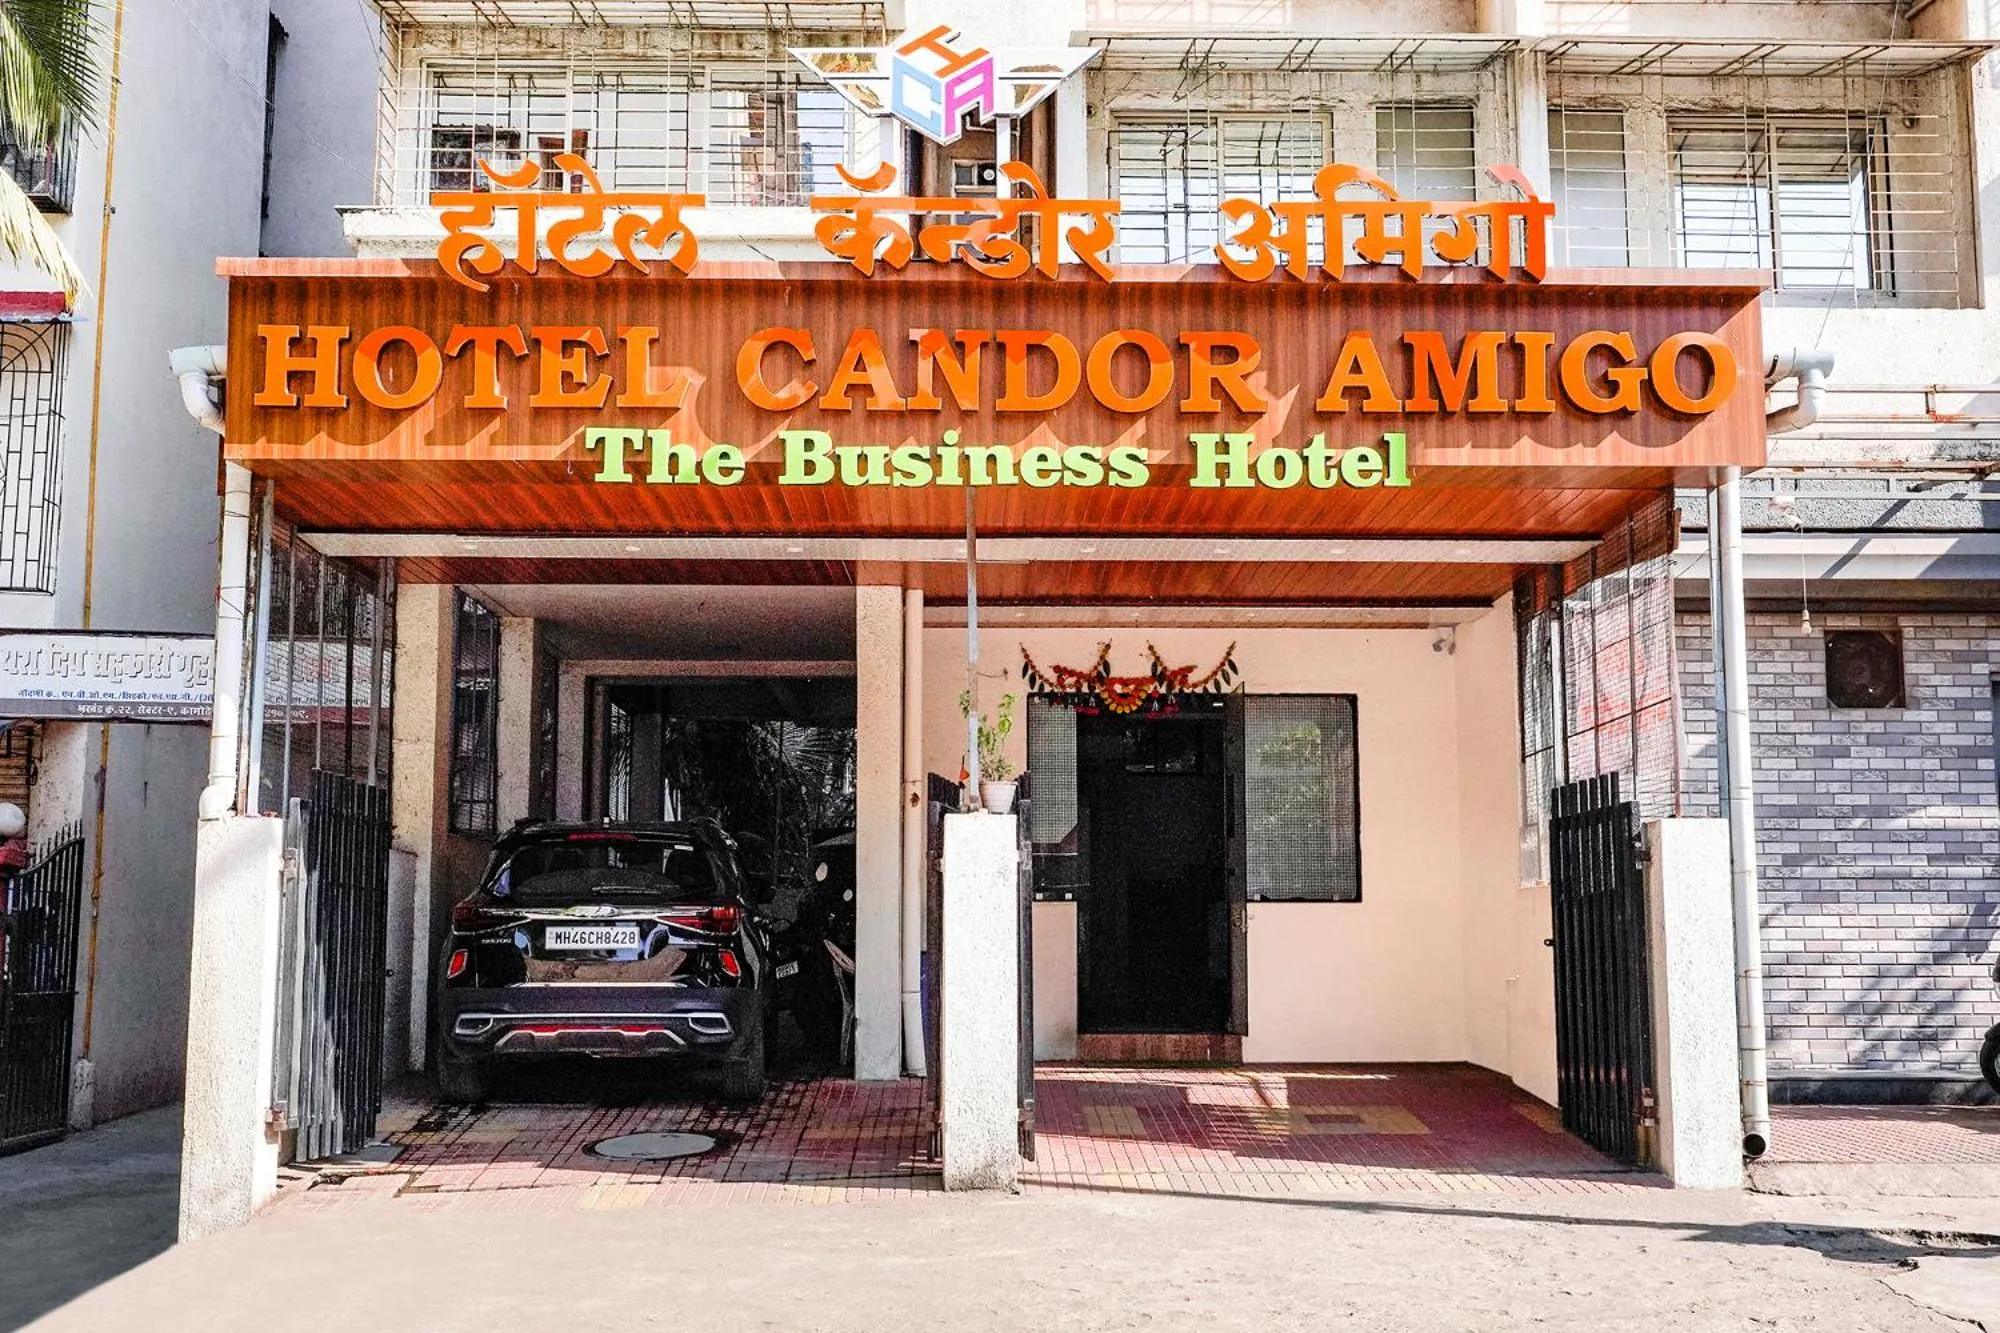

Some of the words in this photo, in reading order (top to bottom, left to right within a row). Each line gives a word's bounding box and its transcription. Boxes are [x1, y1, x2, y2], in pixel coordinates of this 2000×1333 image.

[430, 152, 706, 294] हॉटेल
[809, 160, 1122, 285] कॅन्डोर
[1214, 162, 1556, 284] अमिगो
[253, 322, 692, 410] HOTEL
[735, 326, 1269, 414] CANDOR
[1315, 330, 1739, 415] AMIGO
[584, 426, 747, 486] The
[777, 428, 1150, 488] Business
[1188, 431, 1413, 489] Hotel
[554, 930, 637, 946] MH46CH8428
